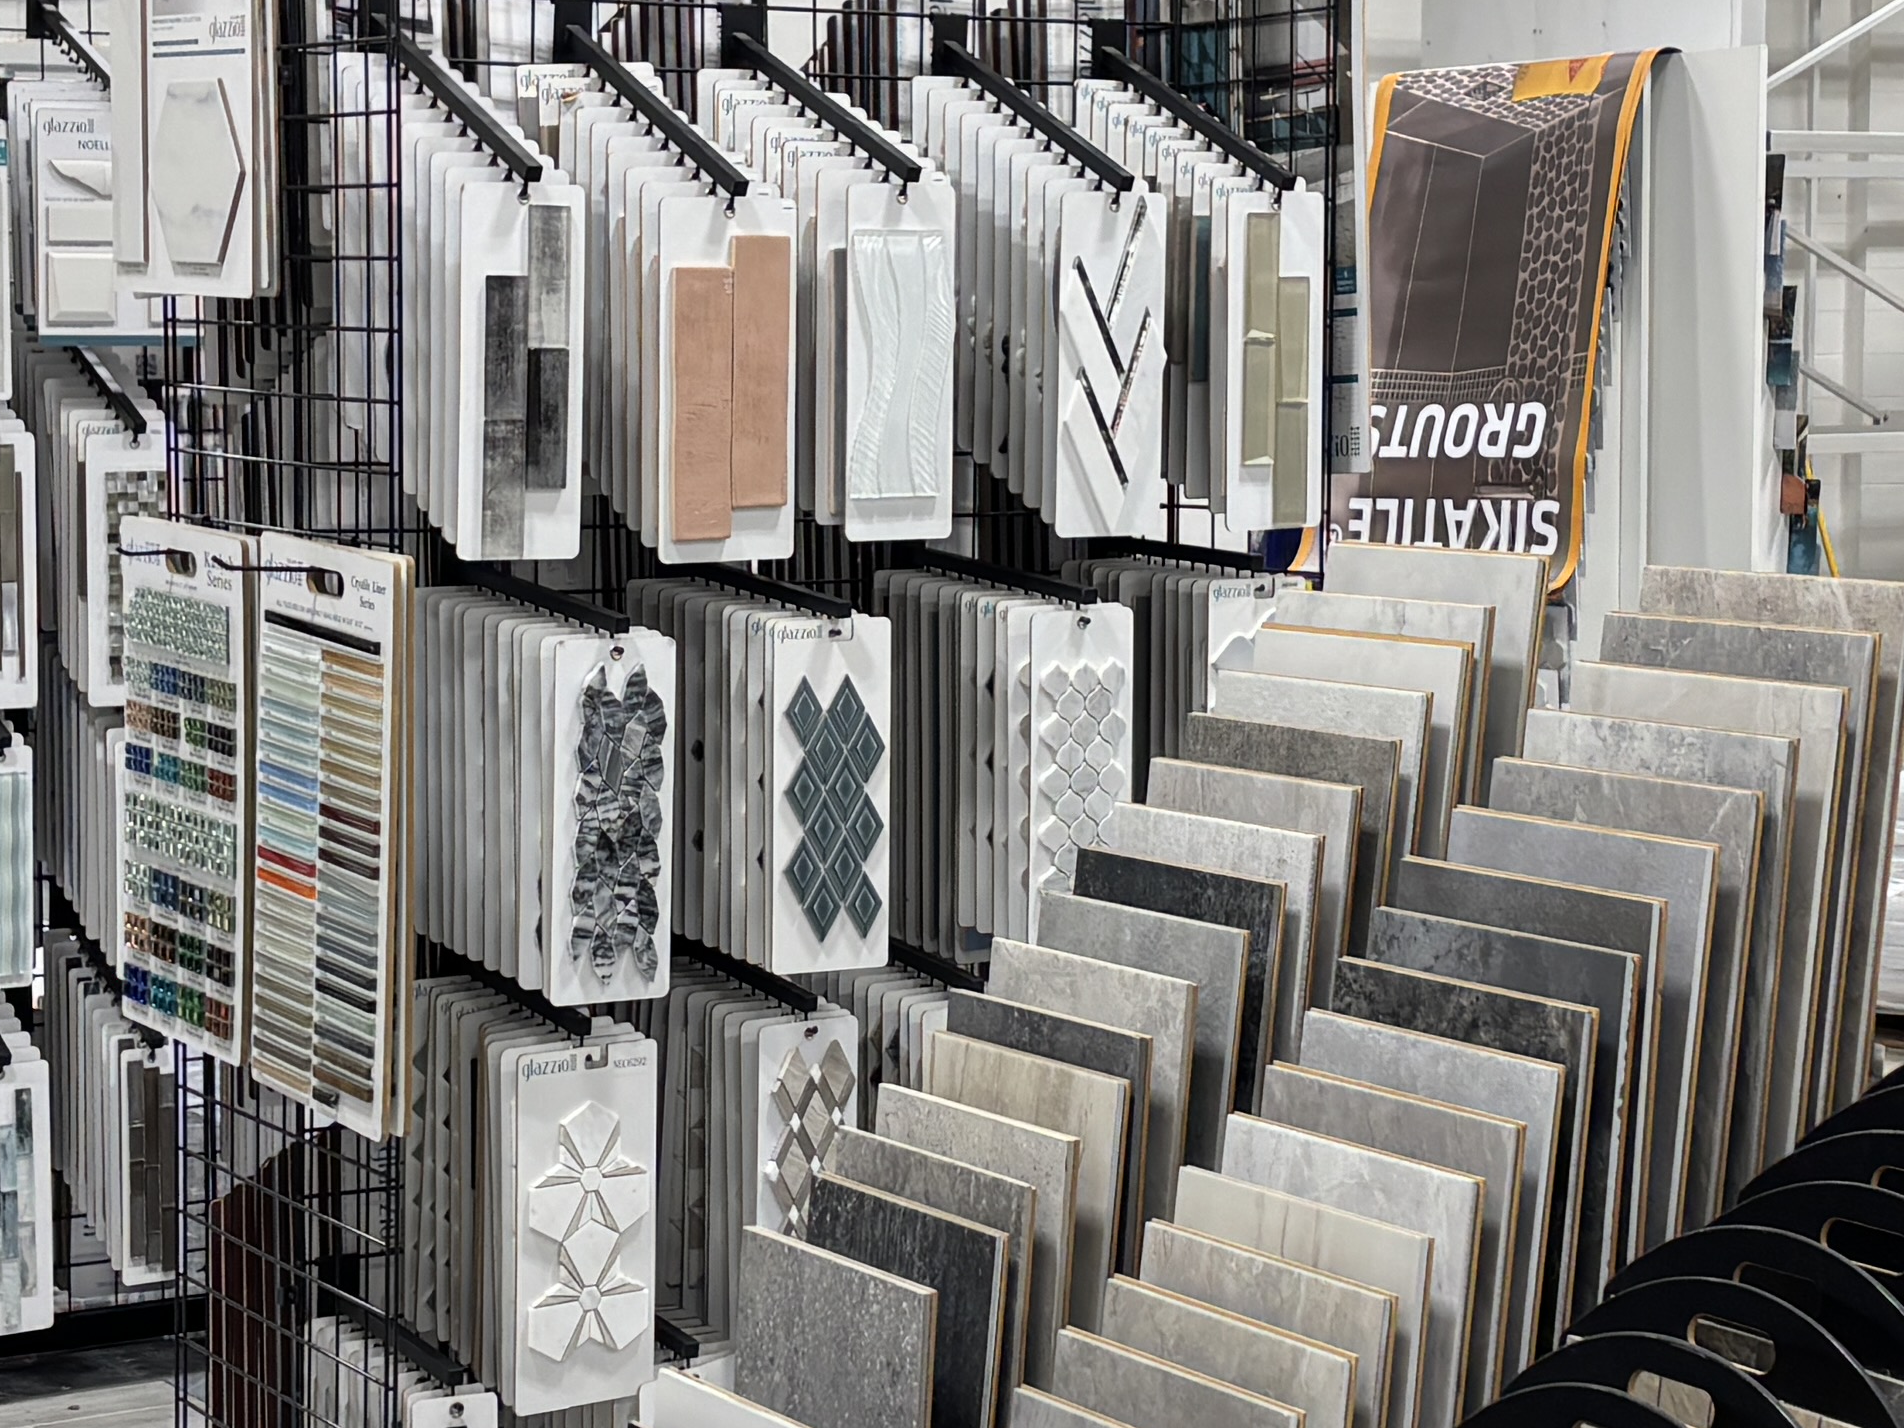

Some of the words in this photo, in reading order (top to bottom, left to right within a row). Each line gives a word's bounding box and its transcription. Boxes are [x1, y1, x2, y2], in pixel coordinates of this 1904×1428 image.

[42, 117, 89, 136] glazzio
[1371, 400, 1547, 460] GROUTS
[207, 570, 232, 591] Series
[1212, 584, 1246, 602] glazzio
[359, 595, 375, 611] Series
[777, 625, 818, 643] glazzio
[522, 1058, 569, 1082] glazzio
